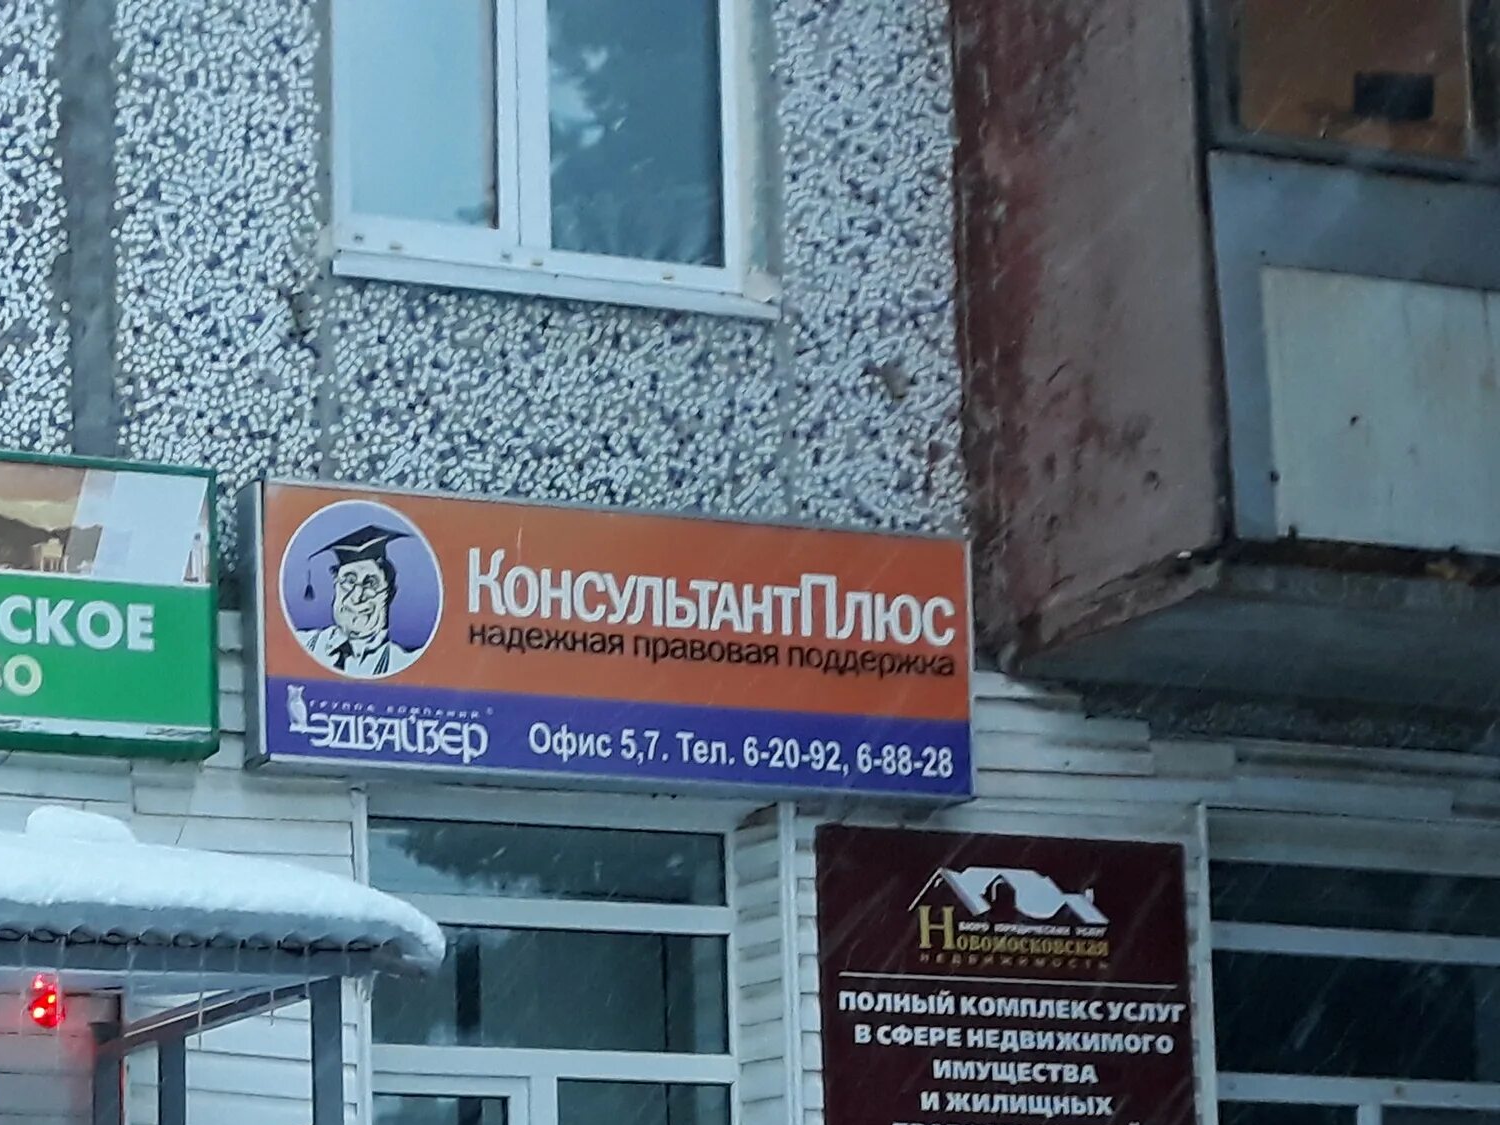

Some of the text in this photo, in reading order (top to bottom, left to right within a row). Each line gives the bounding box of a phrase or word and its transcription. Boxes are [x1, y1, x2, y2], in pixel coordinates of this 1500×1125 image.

[468, 623, 956, 680] надежная правовая поддержка
[528, 721, 954, 779] Офис 5,7. Тел. 6-20-92, 6-88-28
[838, 989, 1187, 1023] ПОЛНЫЙ КОМПЛЕКС УСЛУГ
[854, 1024, 1175, 1055] В СФЕРЕ НЕДВИЖИМОГО
[932, 1059, 1099, 1086] ИМУЩЕСТВА
[920, 1091, 1115, 1118] И ЖИЛИЩНЫХ
